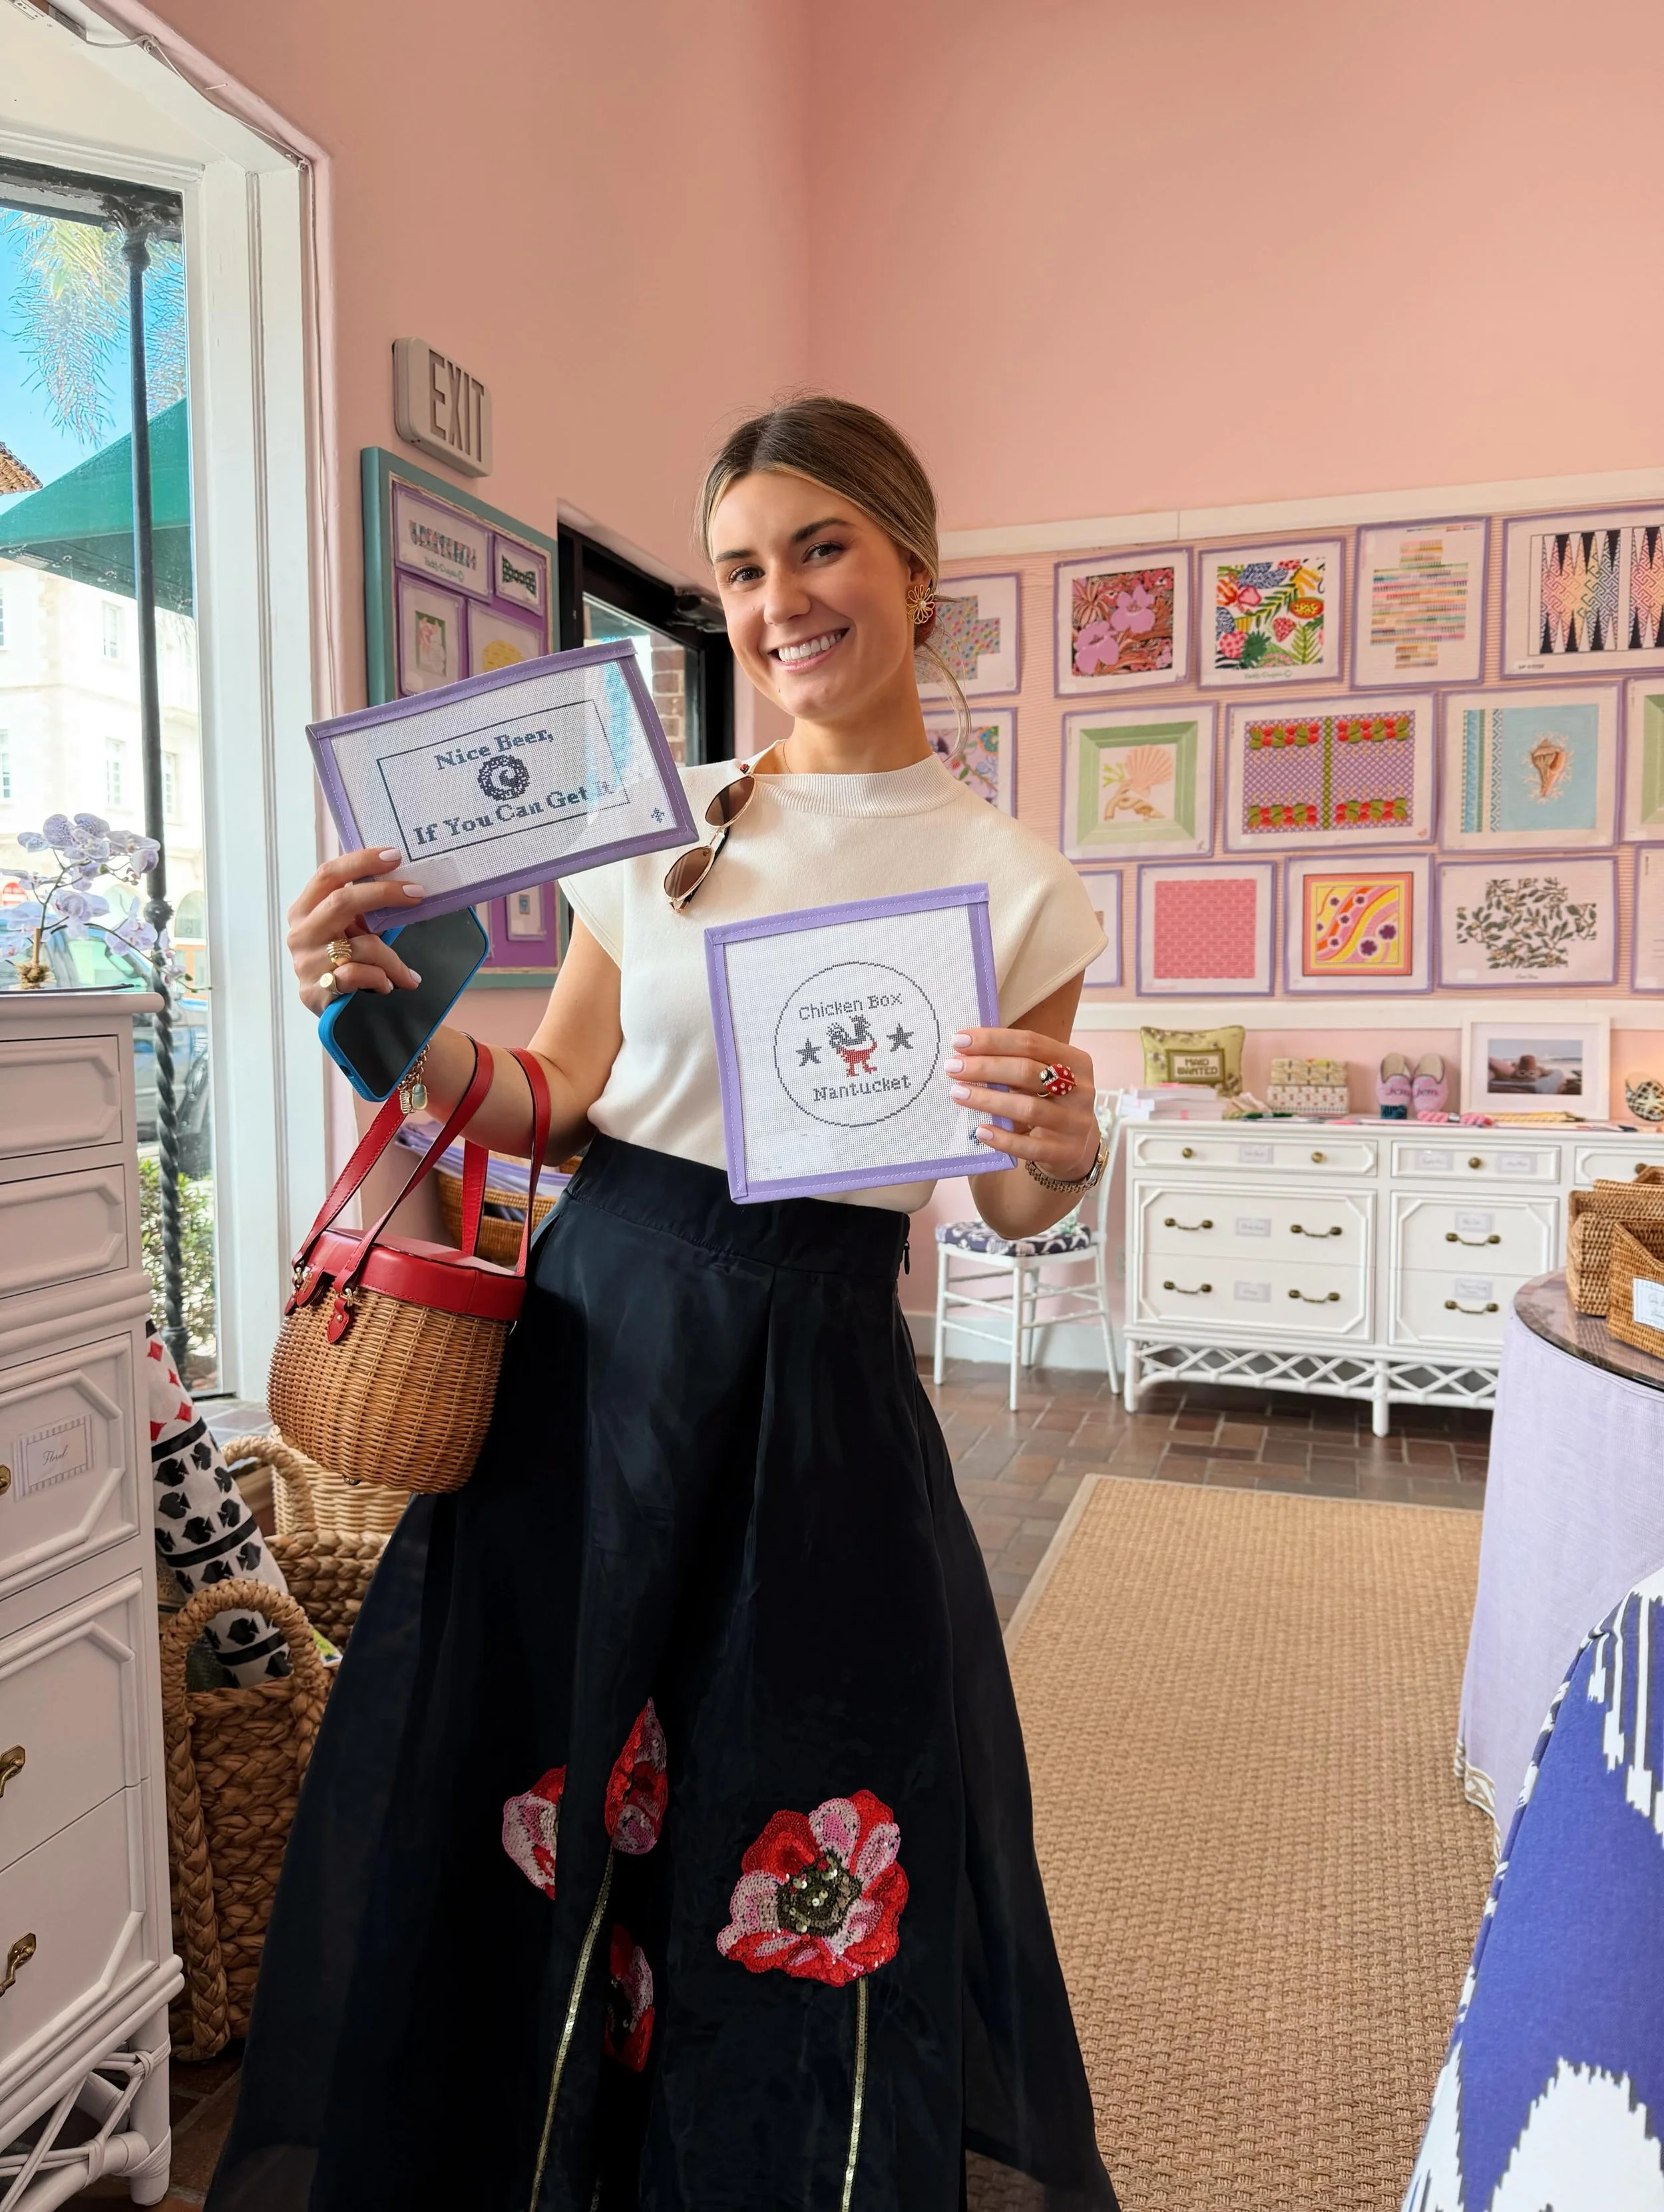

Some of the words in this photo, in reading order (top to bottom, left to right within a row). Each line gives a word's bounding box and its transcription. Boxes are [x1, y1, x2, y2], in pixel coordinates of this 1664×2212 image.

[429, 349, 484, 463] EXIT
[434, 746, 491, 770] Nice
[494, 730, 554, 752] Beer,
[413, 823, 437, 845] If
[443, 815, 493, 836] You
[496, 801, 544, 821] Can
[546, 785, 589, 809] Get
[799, 1000, 863, 1020] Chicken
[867, 993, 903, 1009] Box
[813, 1075, 911, 1102] Nantucket
[43, 1444, 69, 1466] Floral
